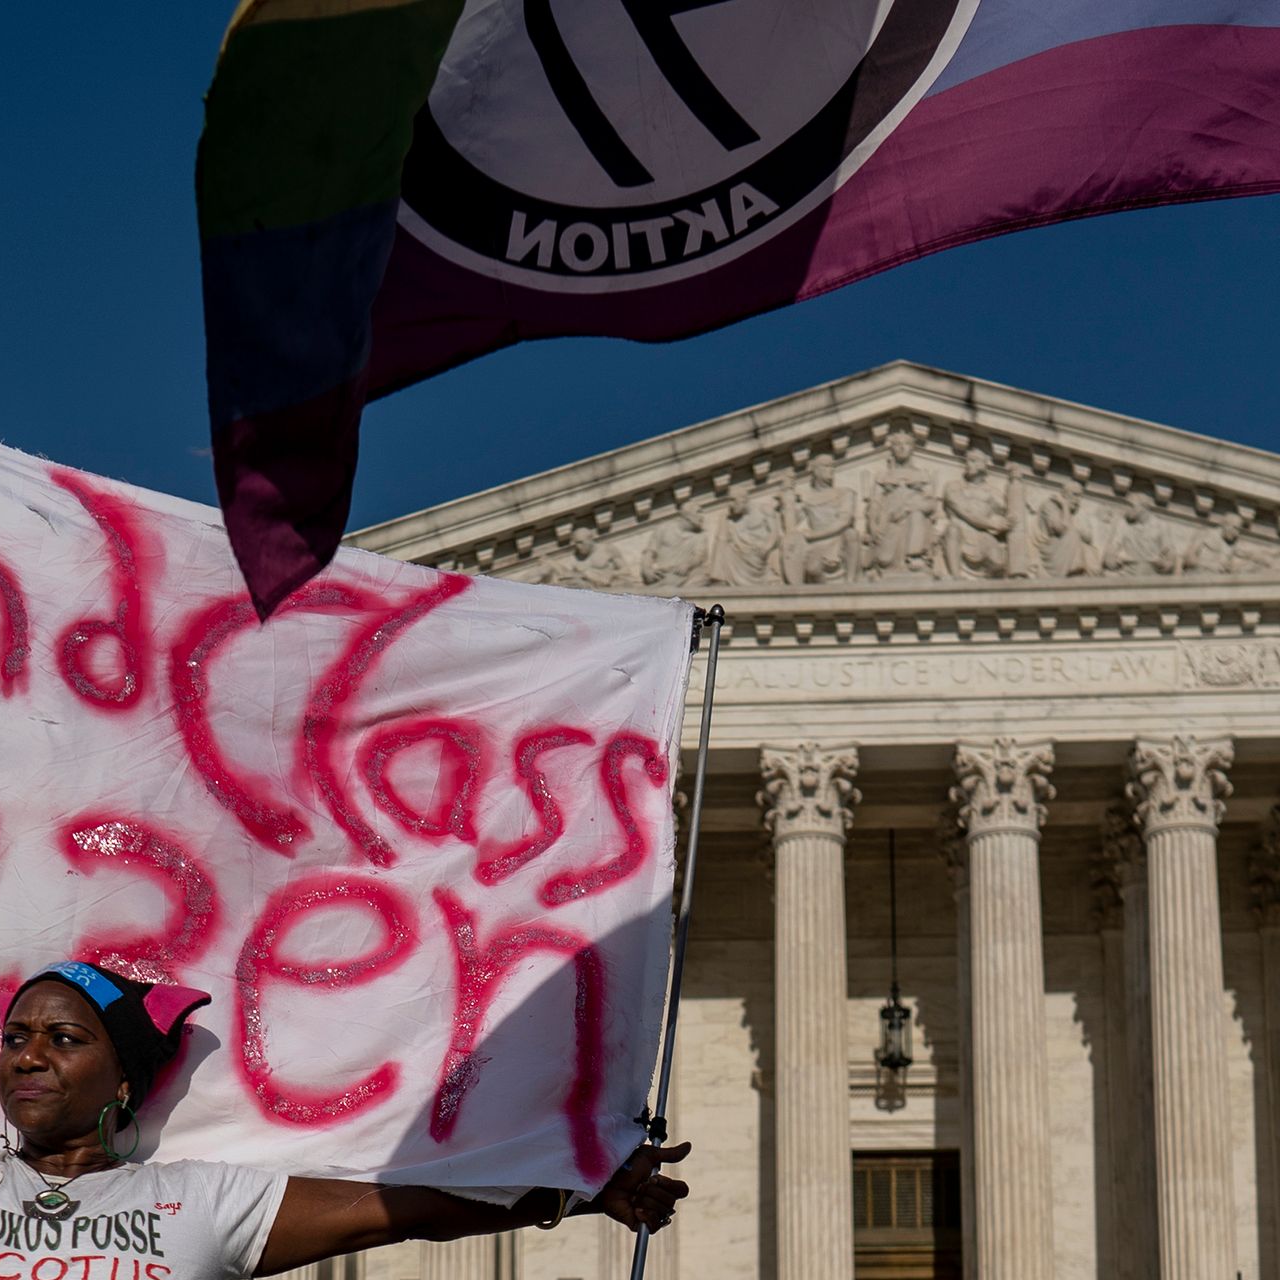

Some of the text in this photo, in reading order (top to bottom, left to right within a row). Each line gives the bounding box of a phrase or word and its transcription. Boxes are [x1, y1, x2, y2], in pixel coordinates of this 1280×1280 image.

[690, 654, 1158, 691] QUAL JUSTICE UNDER LAW
[169, 573, 670, 908] Class
[154, 1201, 182, 1216] says
[72, 1209, 165, 1258] POSSE
